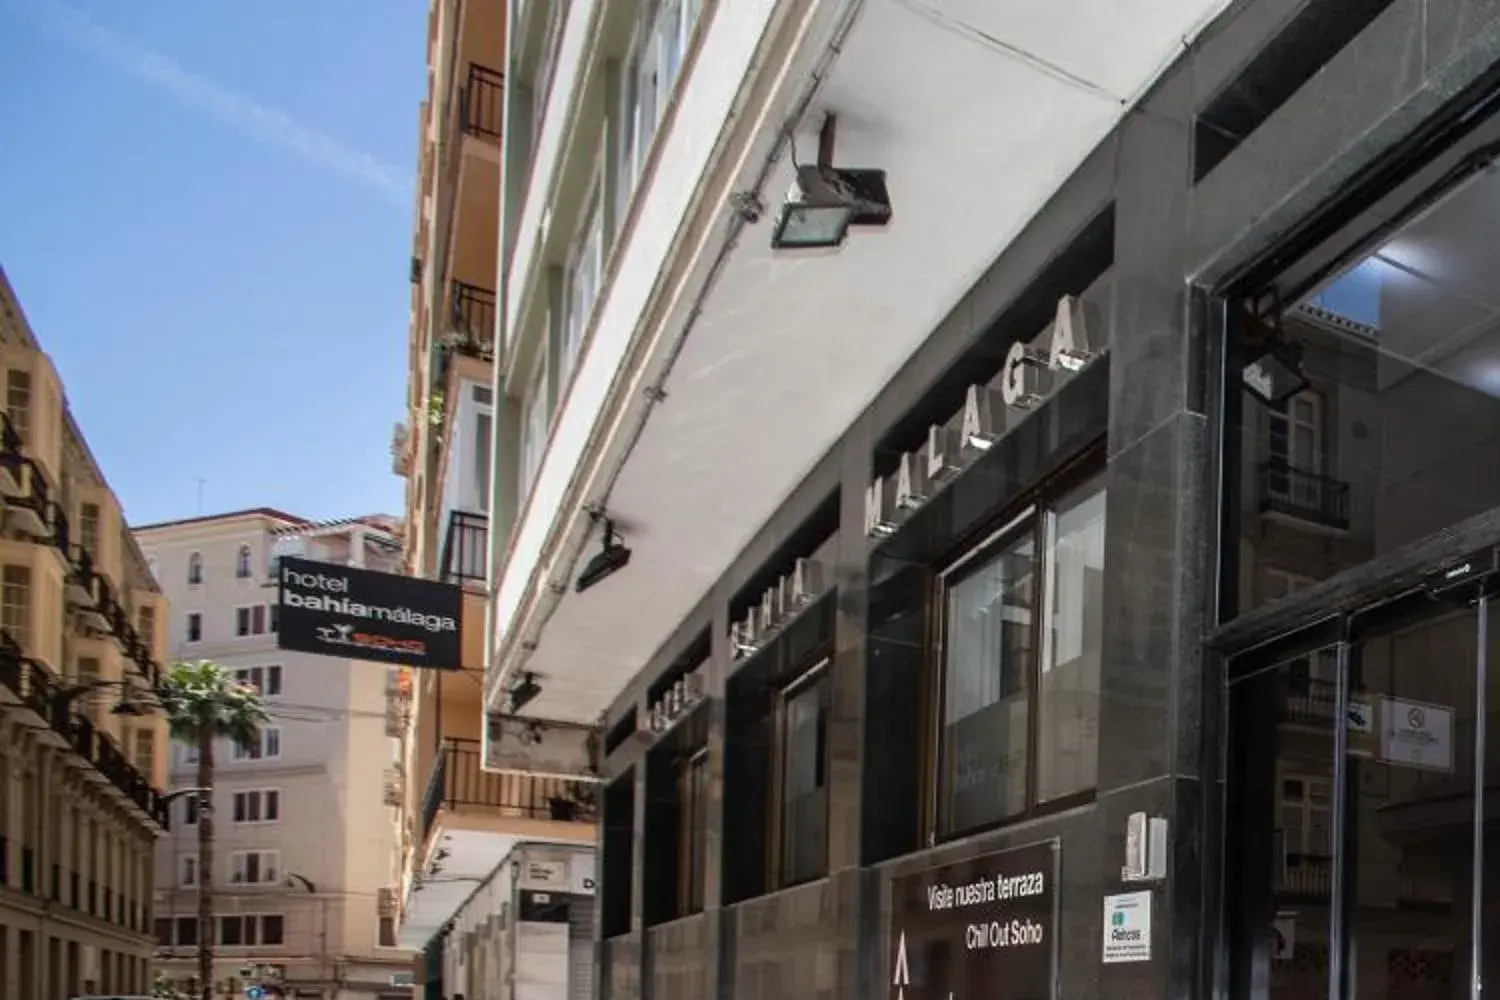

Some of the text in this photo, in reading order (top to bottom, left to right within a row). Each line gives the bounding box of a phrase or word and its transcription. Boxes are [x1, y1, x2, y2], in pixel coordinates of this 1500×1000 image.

[282, 567, 348, 593] hotel
[955, 877, 995, 906] nuestra
[997, 871, 1043, 899] terraza
[966, 918, 1043, 949] Chill Out Soho
